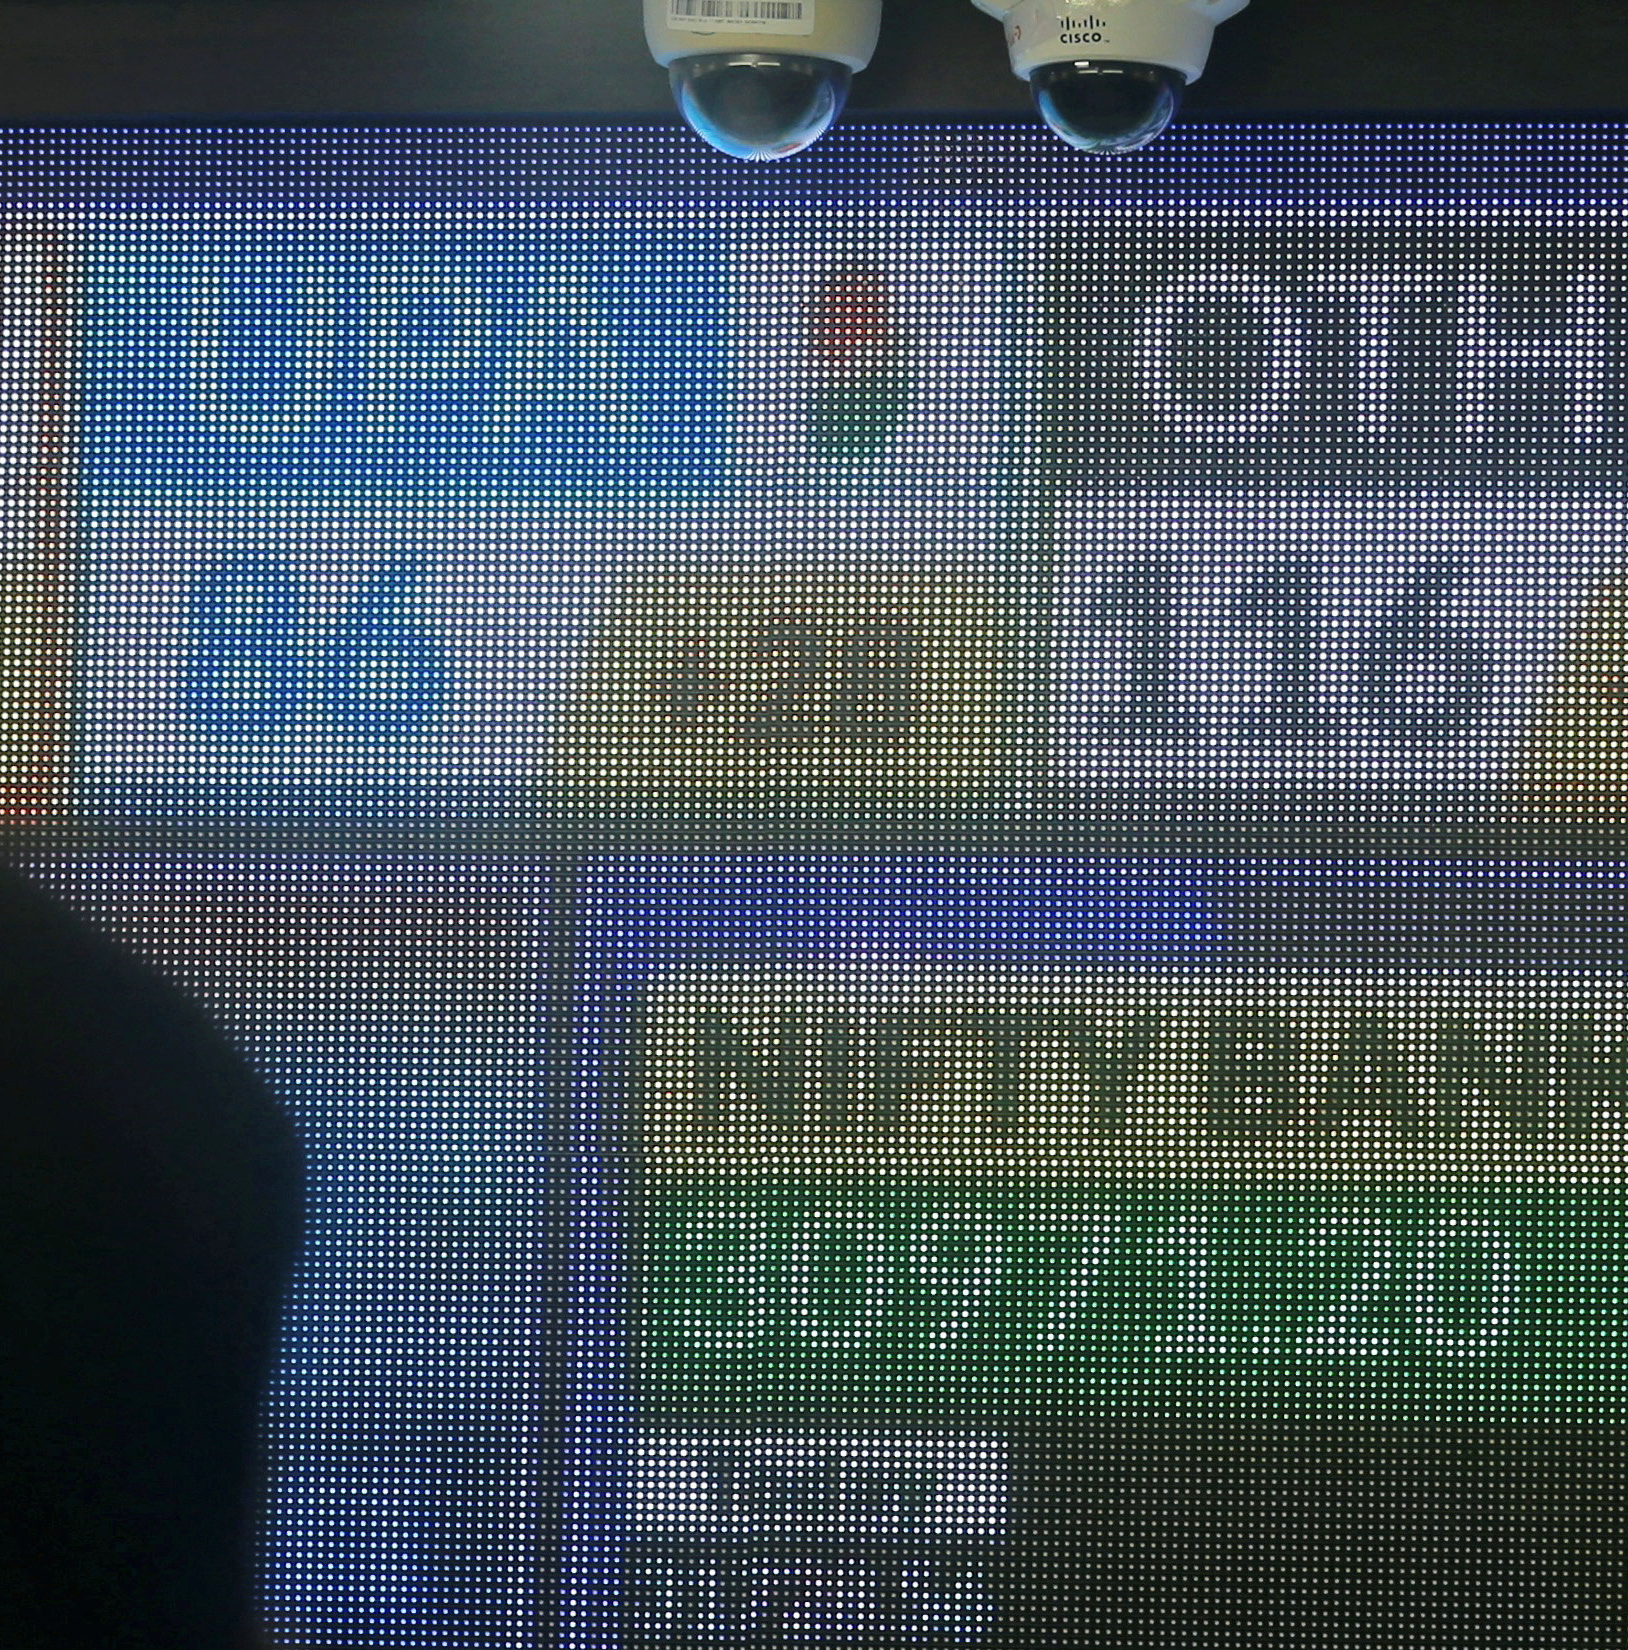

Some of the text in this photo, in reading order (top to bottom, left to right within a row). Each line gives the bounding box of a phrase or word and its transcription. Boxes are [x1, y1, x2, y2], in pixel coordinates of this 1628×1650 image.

[1060, 32, 1102, 44] CISCO
[184, 258, 646, 449] UPA
[1130, 260, 1604, 447] OTH
[178, 553, 450, 744] 86
[645, 612, 923, 748] +28
[1088, 553, 1494, 746] 116
[689, 1006, 1162, 1142] NIFTY
[672, 1201, 1522, 1366] 30971.20
[697, 1447, 940, 1538] Today
[635, 1562, 993, 1643] 31728.56
